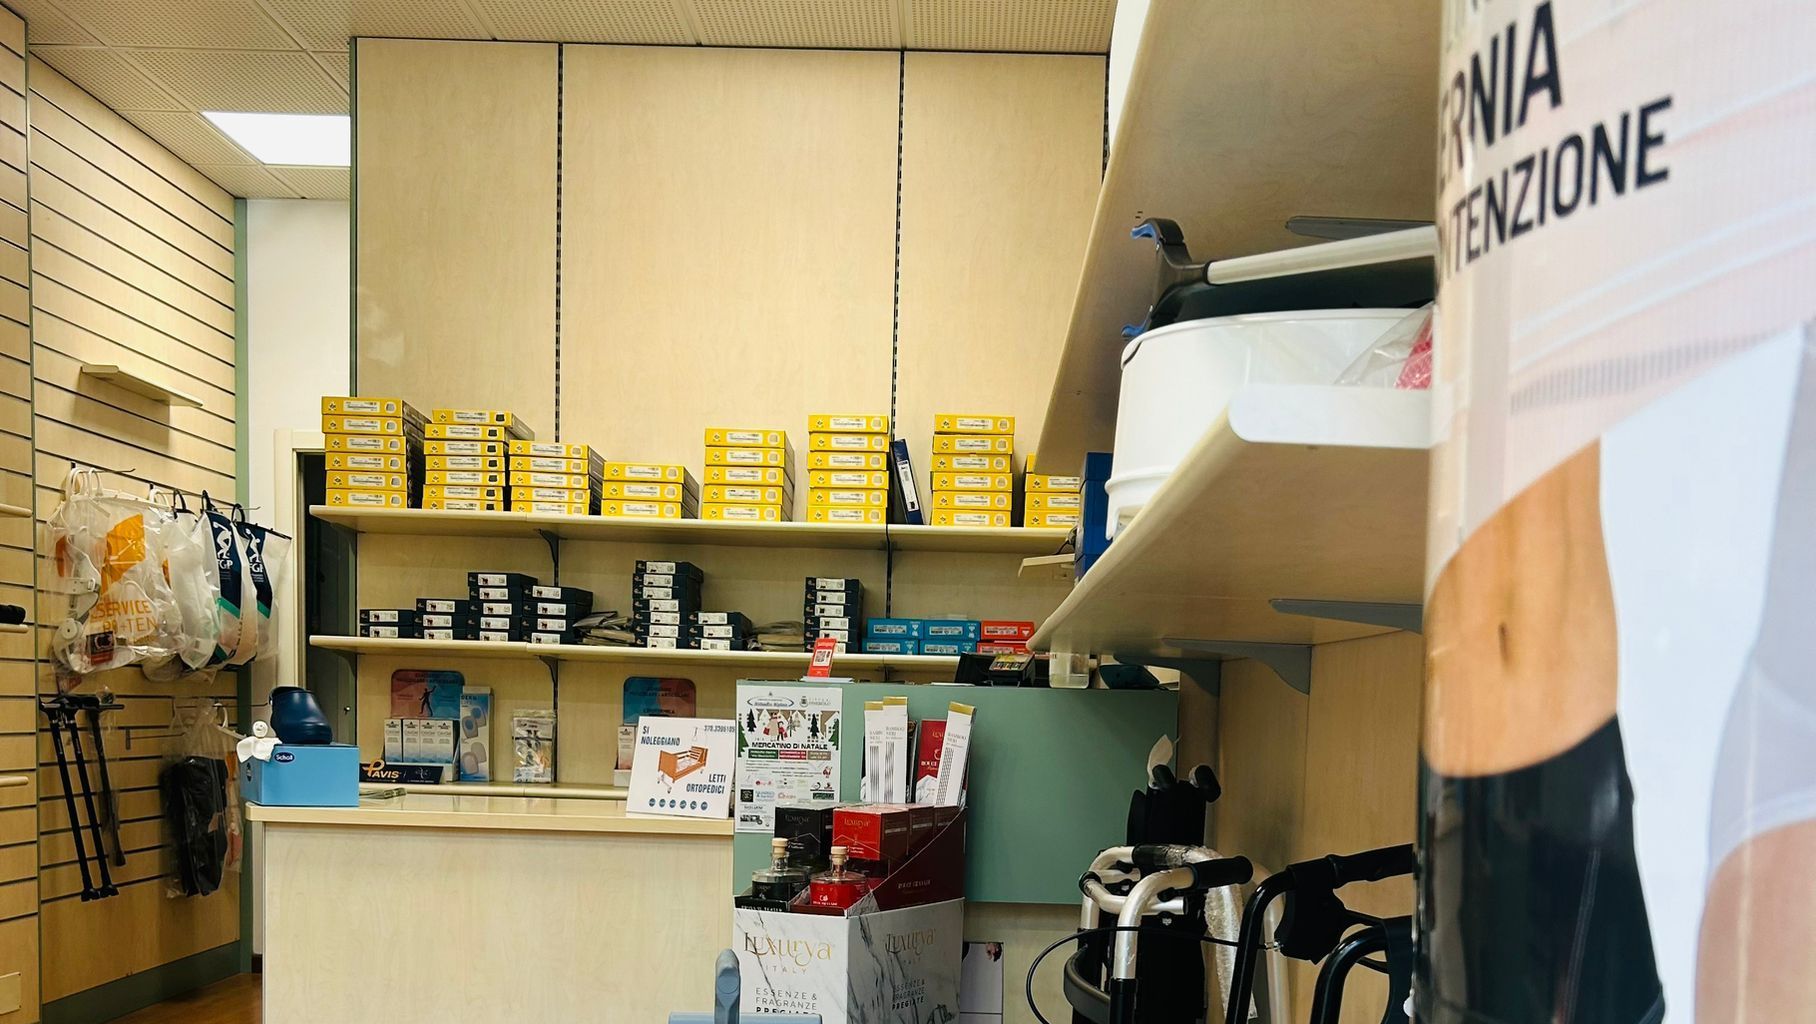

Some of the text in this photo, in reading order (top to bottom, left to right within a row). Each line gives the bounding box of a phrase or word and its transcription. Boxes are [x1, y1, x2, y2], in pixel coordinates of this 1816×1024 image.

[643, 726, 649, 734] SI
[641, 737, 680, 746] NOLEGGIANO
[276, 753, 293, 761] Scholl
[362, 759, 400, 778] PAVIS
[709, 774, 726, 783] LETTI
[686, 784, 725, 794] ORTOPEDICI
[766, 965, 807, 974] ITALY
[756, 988, 818, 1001] ESSENZE &
[756, 997, 817, 1010] FRAGRANZE
